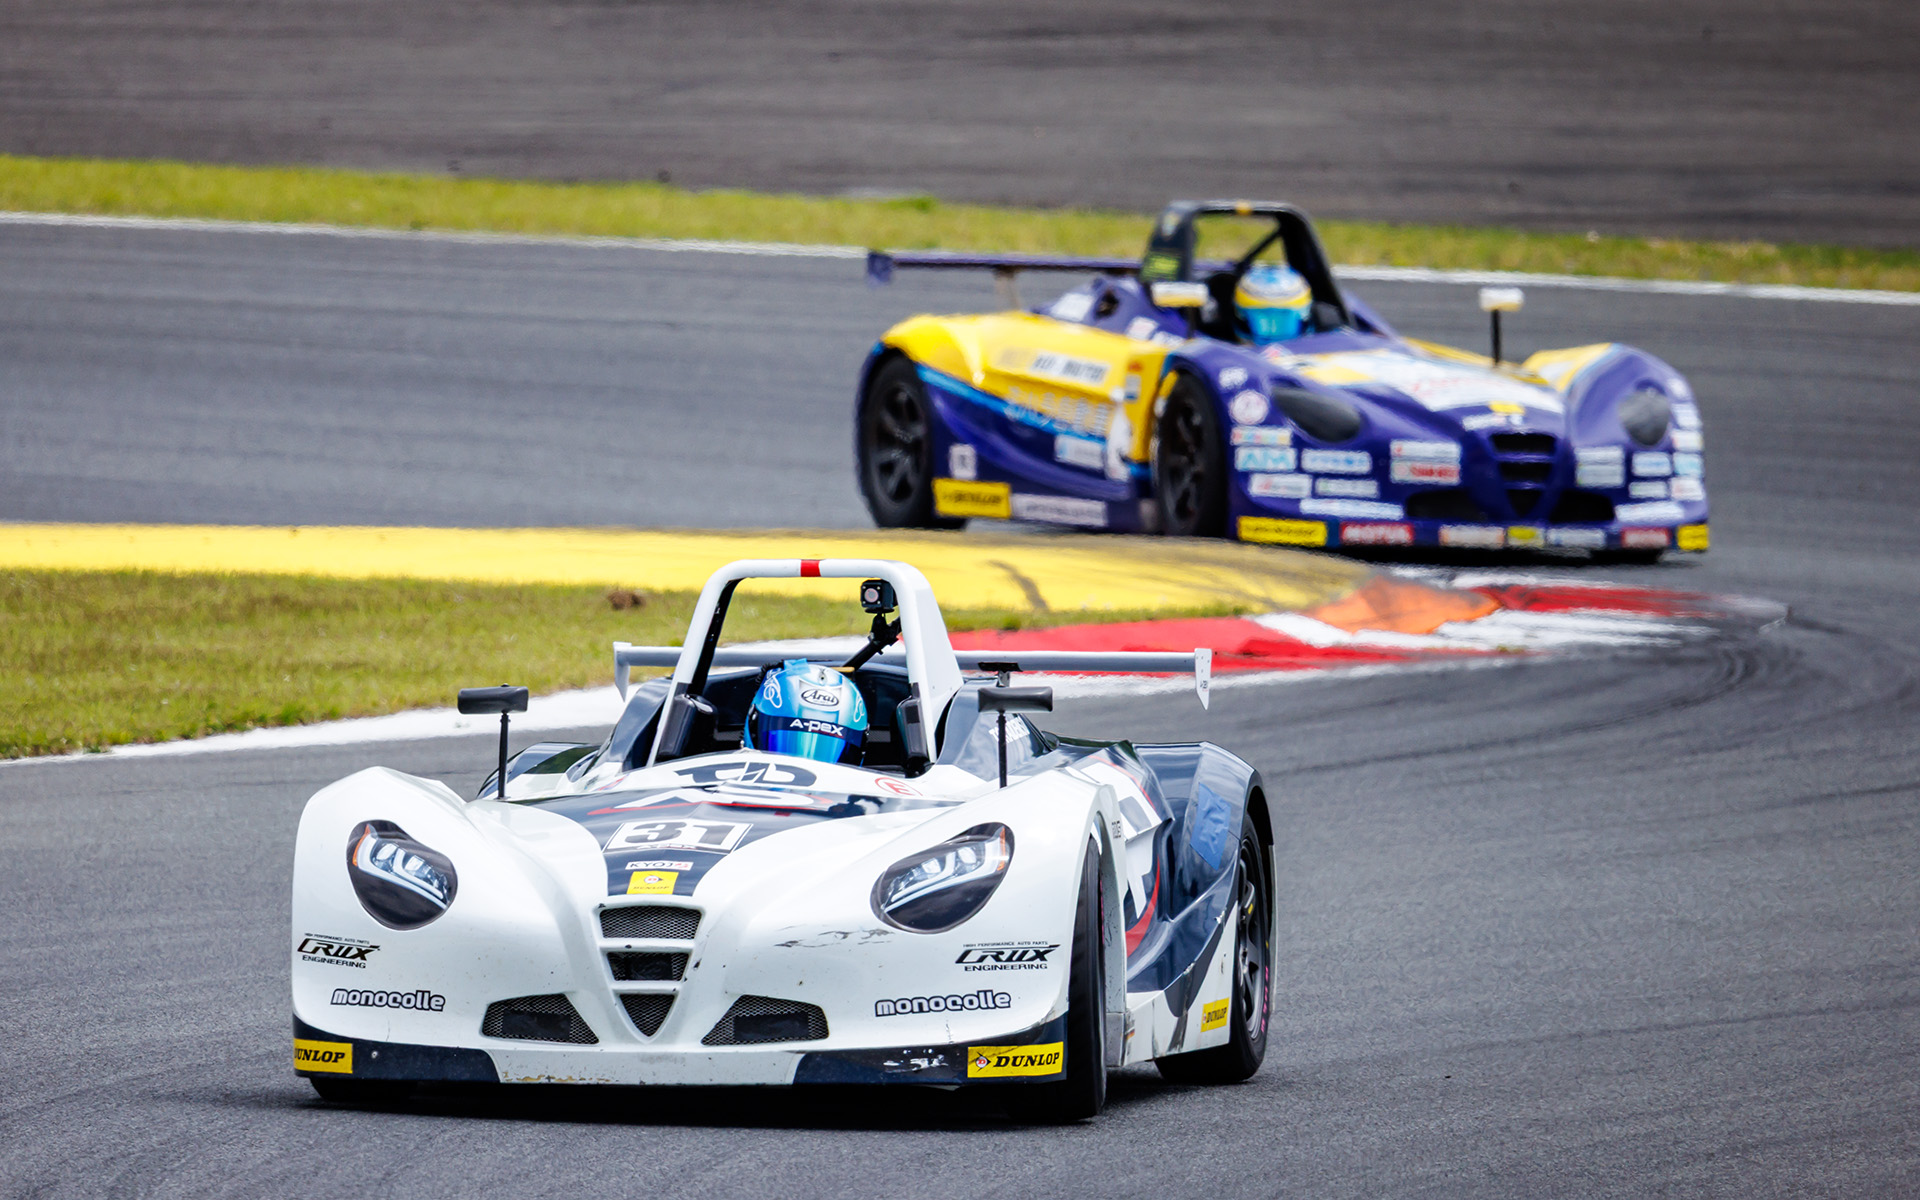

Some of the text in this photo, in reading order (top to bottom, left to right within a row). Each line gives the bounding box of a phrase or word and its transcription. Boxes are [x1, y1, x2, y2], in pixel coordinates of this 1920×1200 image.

[807, 690, 835, 703] Arai
[789, 718, 844, 736] A-pex
[624, 822, 736, 845] 31
[302, 954, 366, 969] ENGINEERING
[964, 963, 1048, 972] ENGINEERING
[330, 988, 446, 1012] monocolle
[875, 989, 1012, 1017] monocolle
[993, 1051, 1060, 1068] DUNLOP
